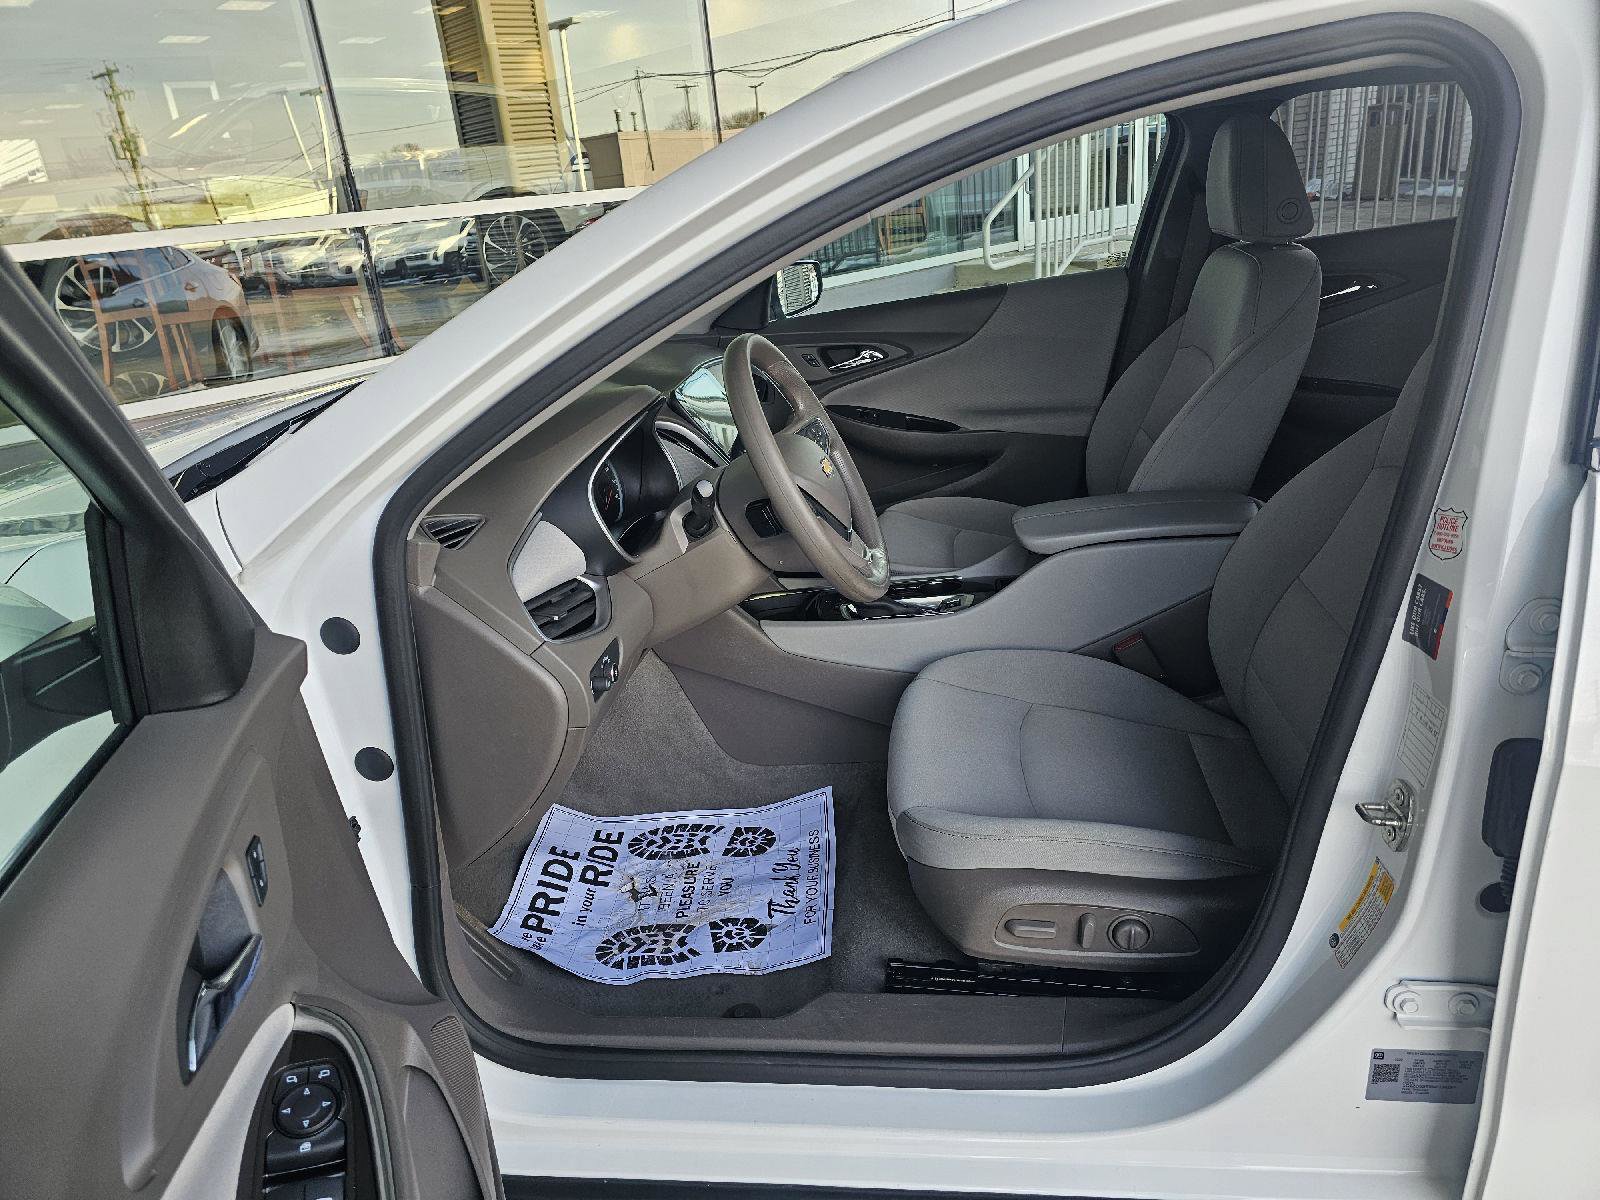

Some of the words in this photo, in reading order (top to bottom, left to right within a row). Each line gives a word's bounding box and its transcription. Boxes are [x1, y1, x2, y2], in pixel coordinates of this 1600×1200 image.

[578, 829, 625, 888] RIDE
[772, 847, 801, 874] You
[807, 829, 820, 874] BUSINESS
[520, 845, 580, 935] PRIDE
[675, 861, 701, 918] PLEASURE
[701, 865, 718, 898] SERVE
[718, 877, 735, 897] YOU
[767, 873, 801, 919] Thank
[805, 875, 820, 904] YOUR
[580, 887, 596, 912] your
[697, 899, 710, 912] TO
[804, 903, 818, 925] FOR
[572, 915, 587, 926] in
